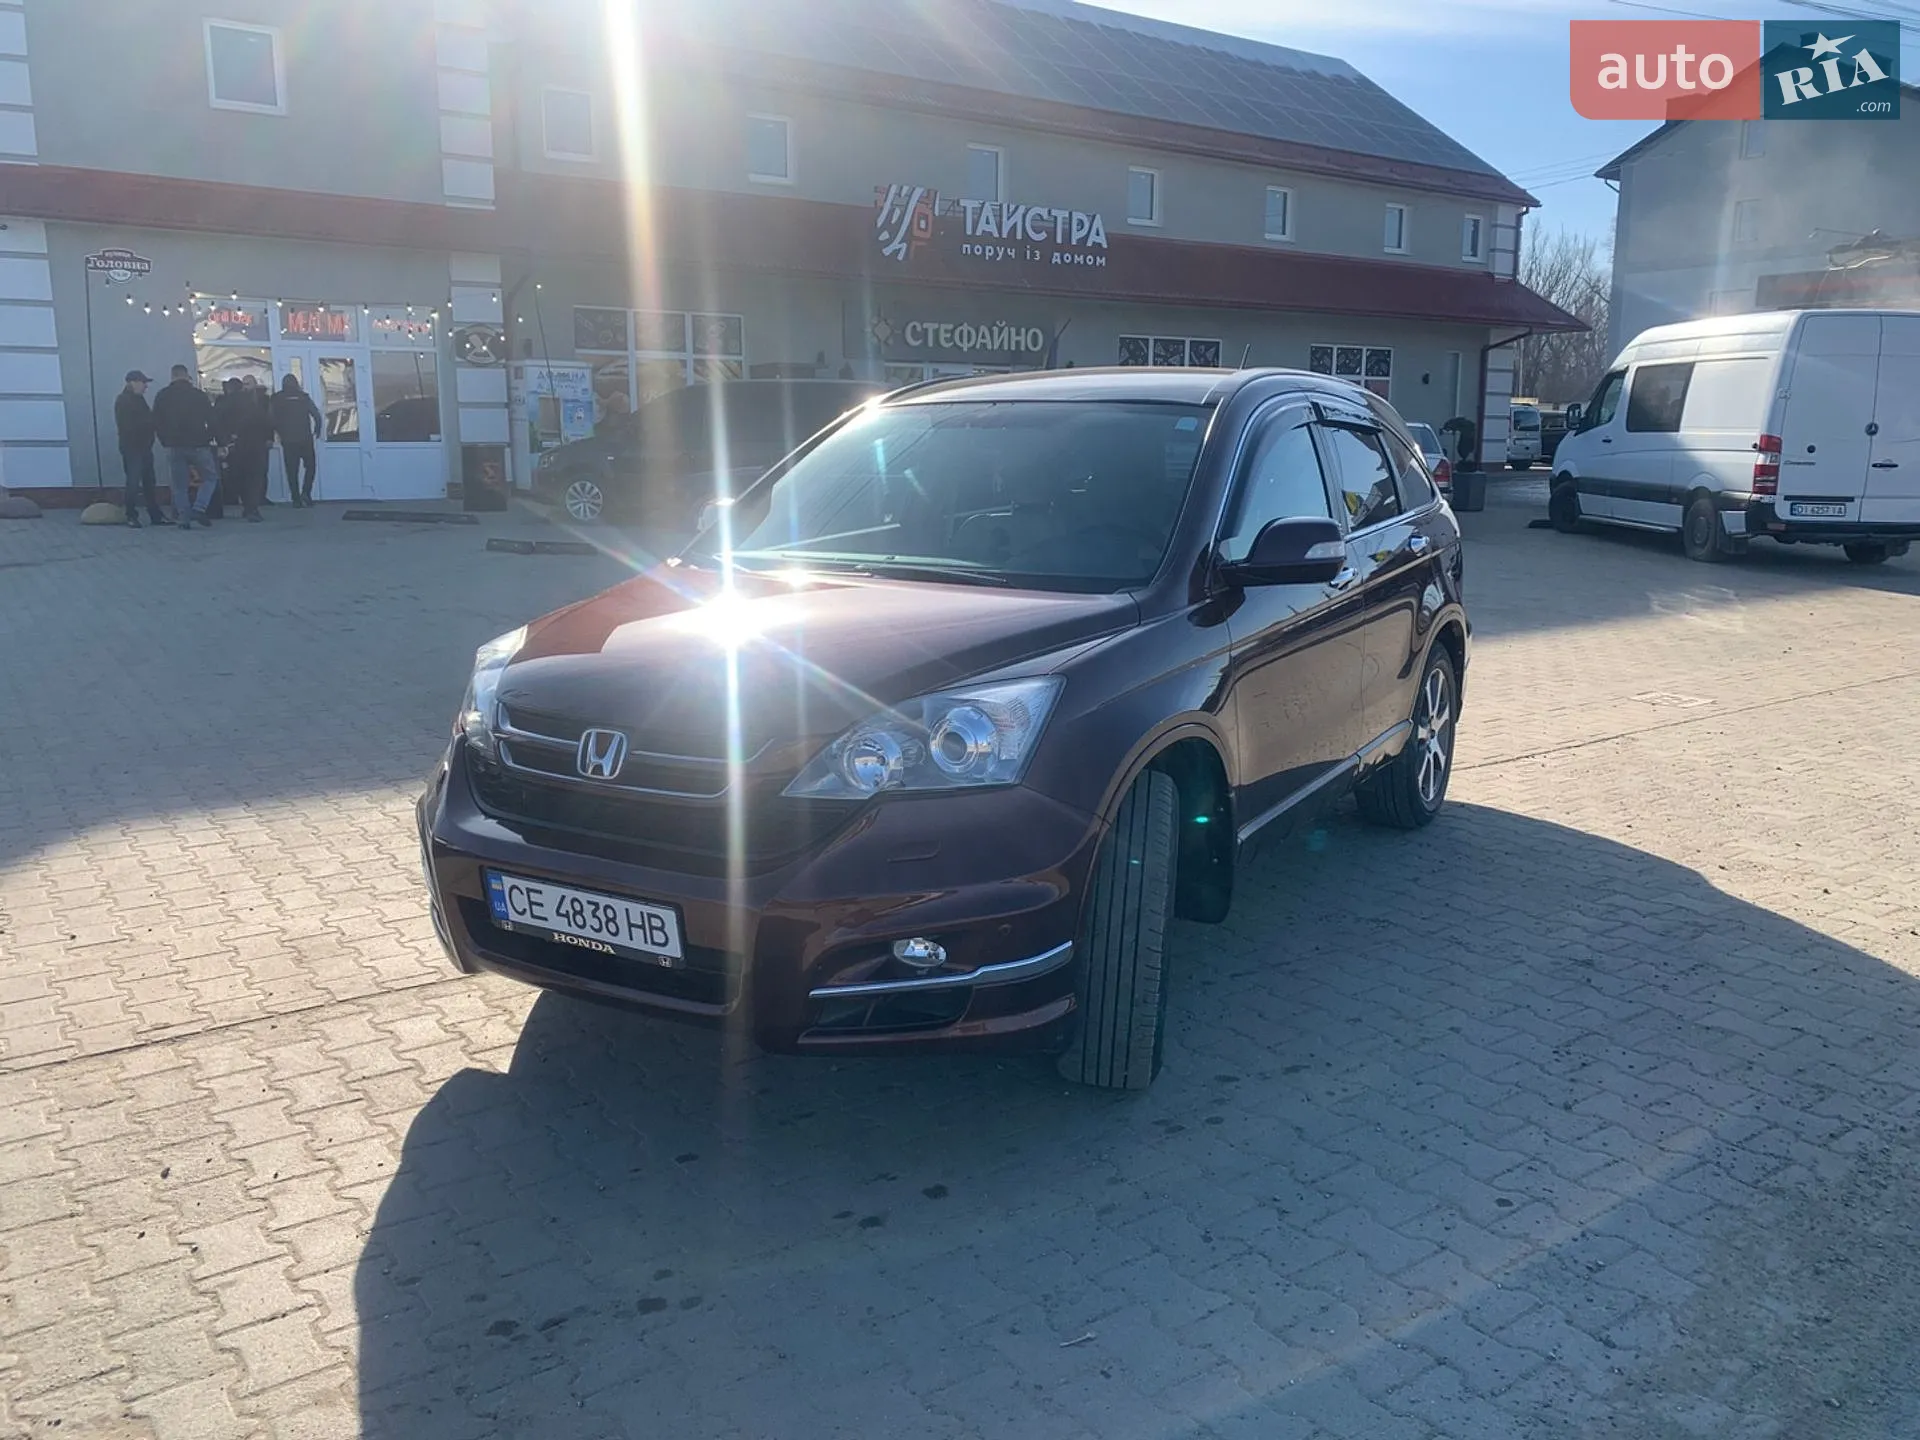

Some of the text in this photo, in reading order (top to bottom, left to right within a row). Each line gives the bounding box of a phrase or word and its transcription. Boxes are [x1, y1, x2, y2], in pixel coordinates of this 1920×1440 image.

[88, 257, 150, 271] Головна
[962, 243, 1107, 267] поруч із домом
[904, 320, 1044, 352] СТЕФАЙНО
[494, 884, 669, 948] UA CE 4838 HB
[553, 931, 617, 955] HONDA
